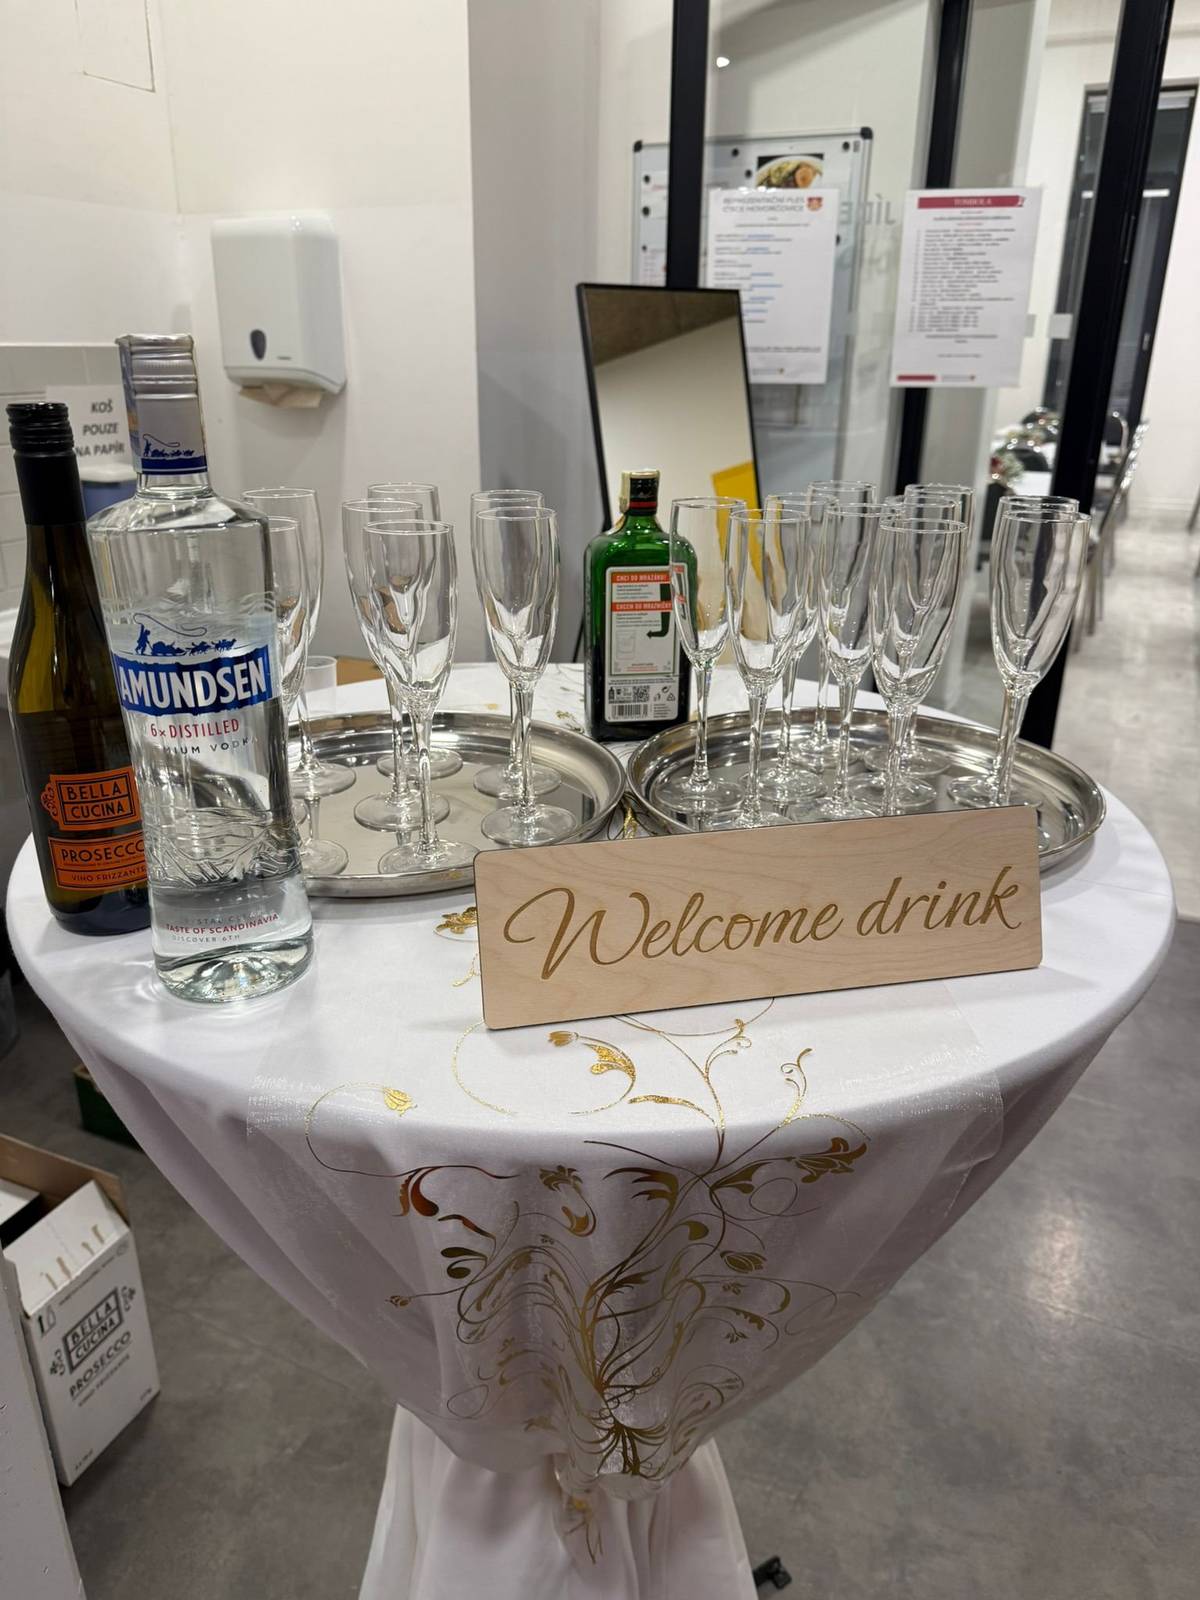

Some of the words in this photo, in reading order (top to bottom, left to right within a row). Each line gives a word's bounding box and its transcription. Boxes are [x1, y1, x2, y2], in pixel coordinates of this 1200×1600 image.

[91, 398, 113, 414] KOŠ
[83, 422, 119, 436] POUZE
[76, 445, 91, 457] NA
[93, 440, 124, 455] PAPÍR
[119, 657, 267, 708] AMUNDSEN
[169, 718, 240, 739] DISTILLED
[66, 781, 122, 801] BELLA
[71, 801, 125, 819] CUCINA
[166, 923, 190, 934] TASTE
[192, 926, 206, 935] OF
[209, 913, 279, 935] SCANDINAVIA
[503, 886, 844, 980] Welcome
[856, 864, 1022, 938] drink
[71, 1301, 114, 1345] BELLA
[75, 1318, 116, 1359] CUCINA
[69, 1331, 132, 1397] PROSECCO
